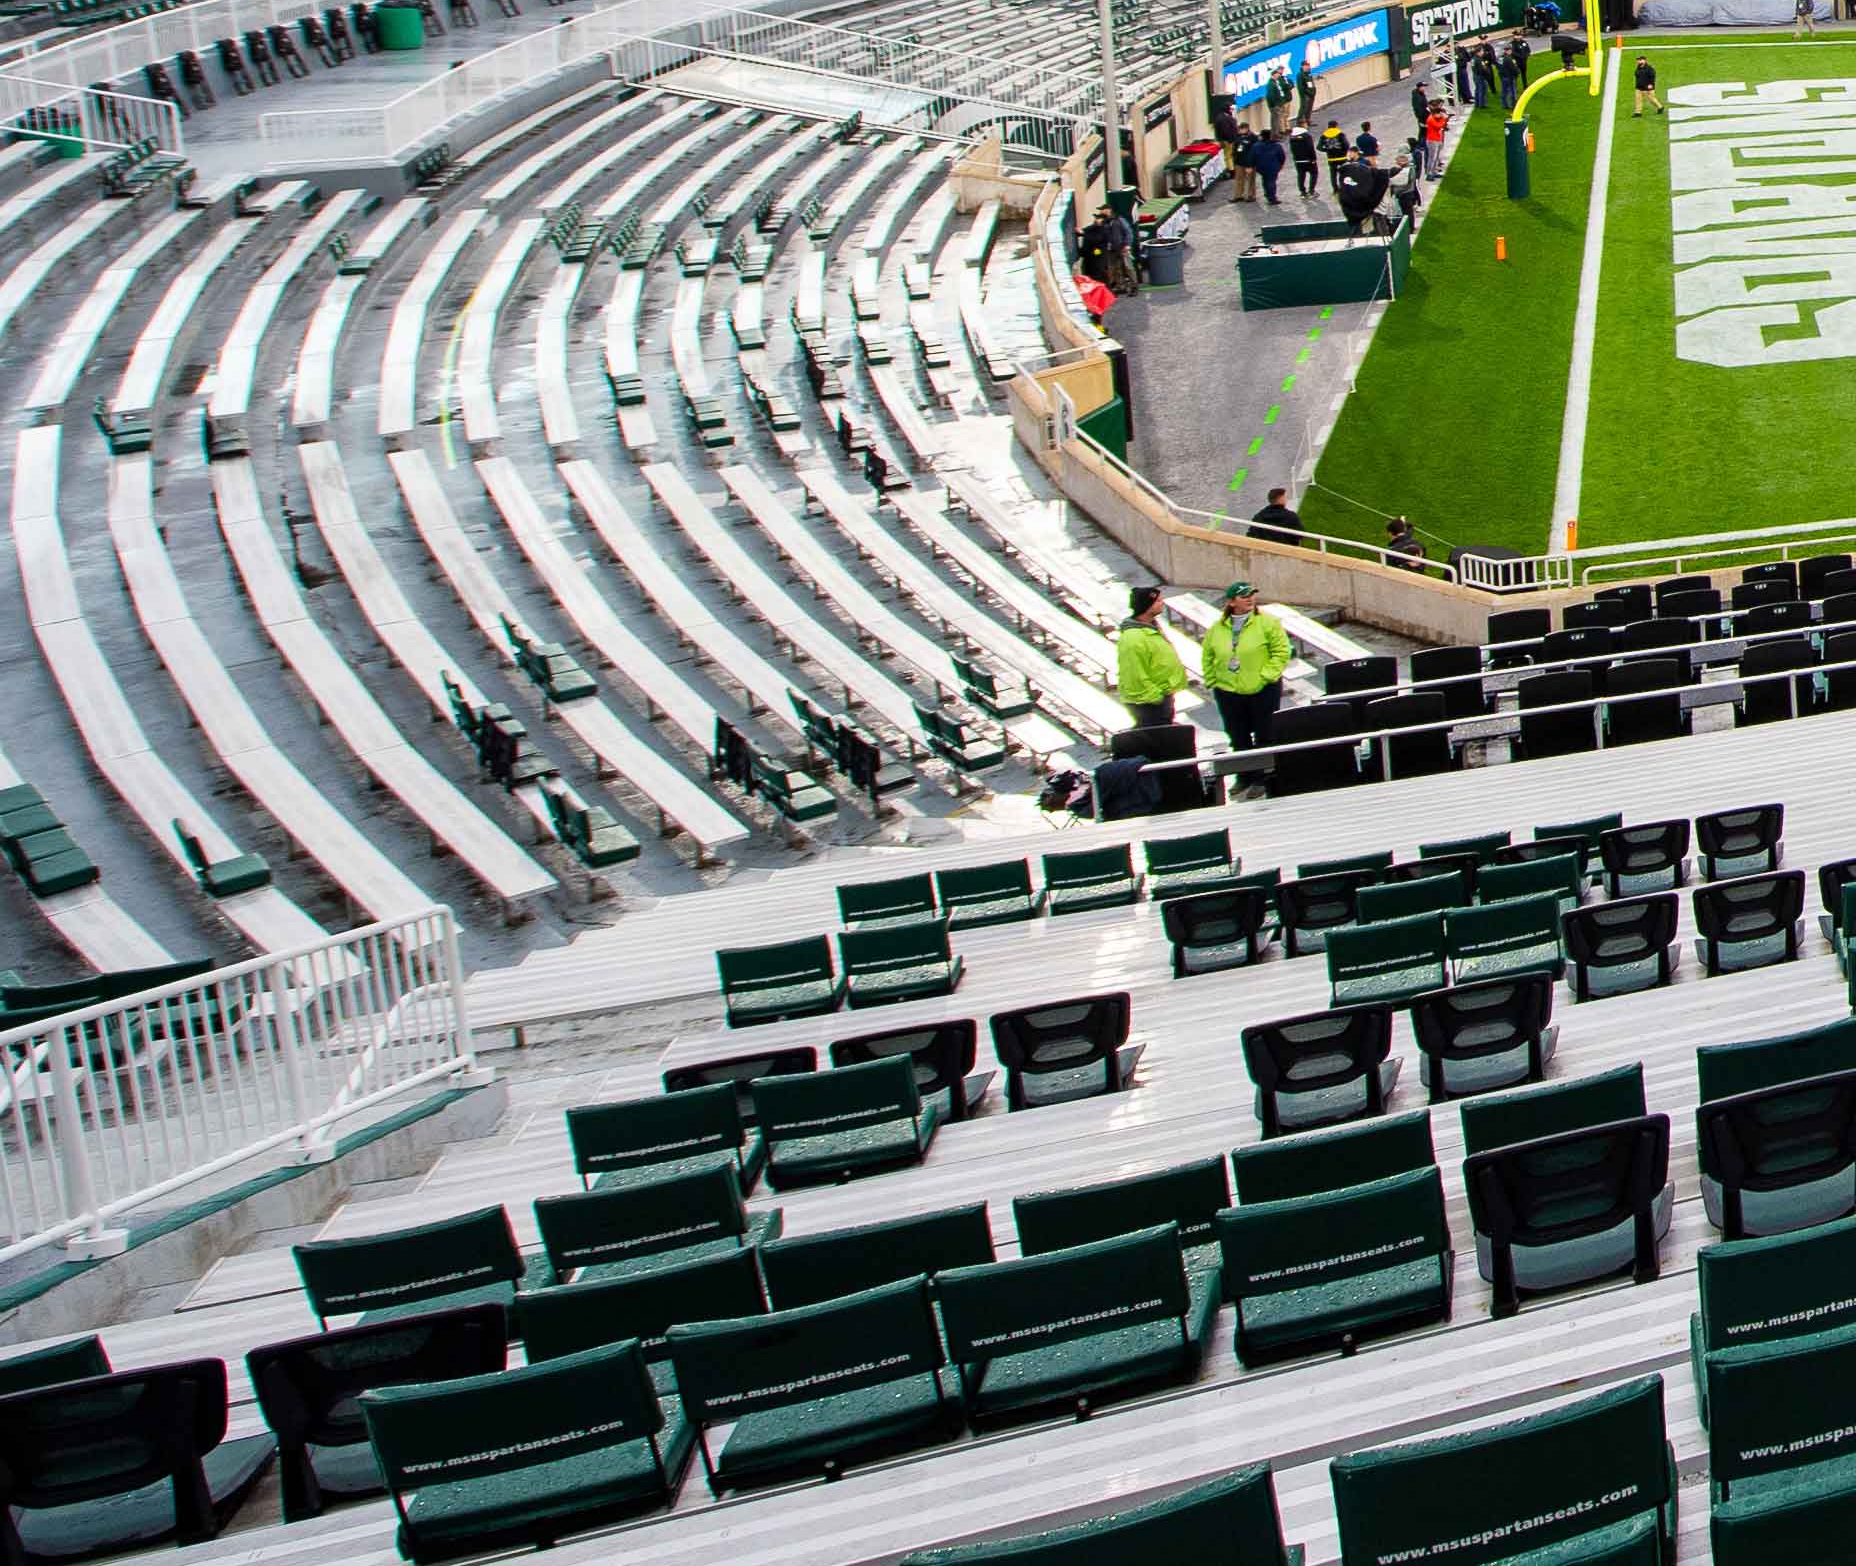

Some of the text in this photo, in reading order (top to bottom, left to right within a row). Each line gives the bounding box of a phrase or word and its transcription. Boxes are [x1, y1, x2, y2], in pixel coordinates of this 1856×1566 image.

[1248, 1234, 1426, 1282] www.msuspartanseats.com
[970, 1296, 1163, 1346] www.msuspartanseats.com
[705, 1351, 911, 1405] www.msuspartanseats.com
[402, 1418, 624, 1472] www.msuspartanseats.com
[1377, 1482, 1639, 1566] www.msuspartanseats.com
